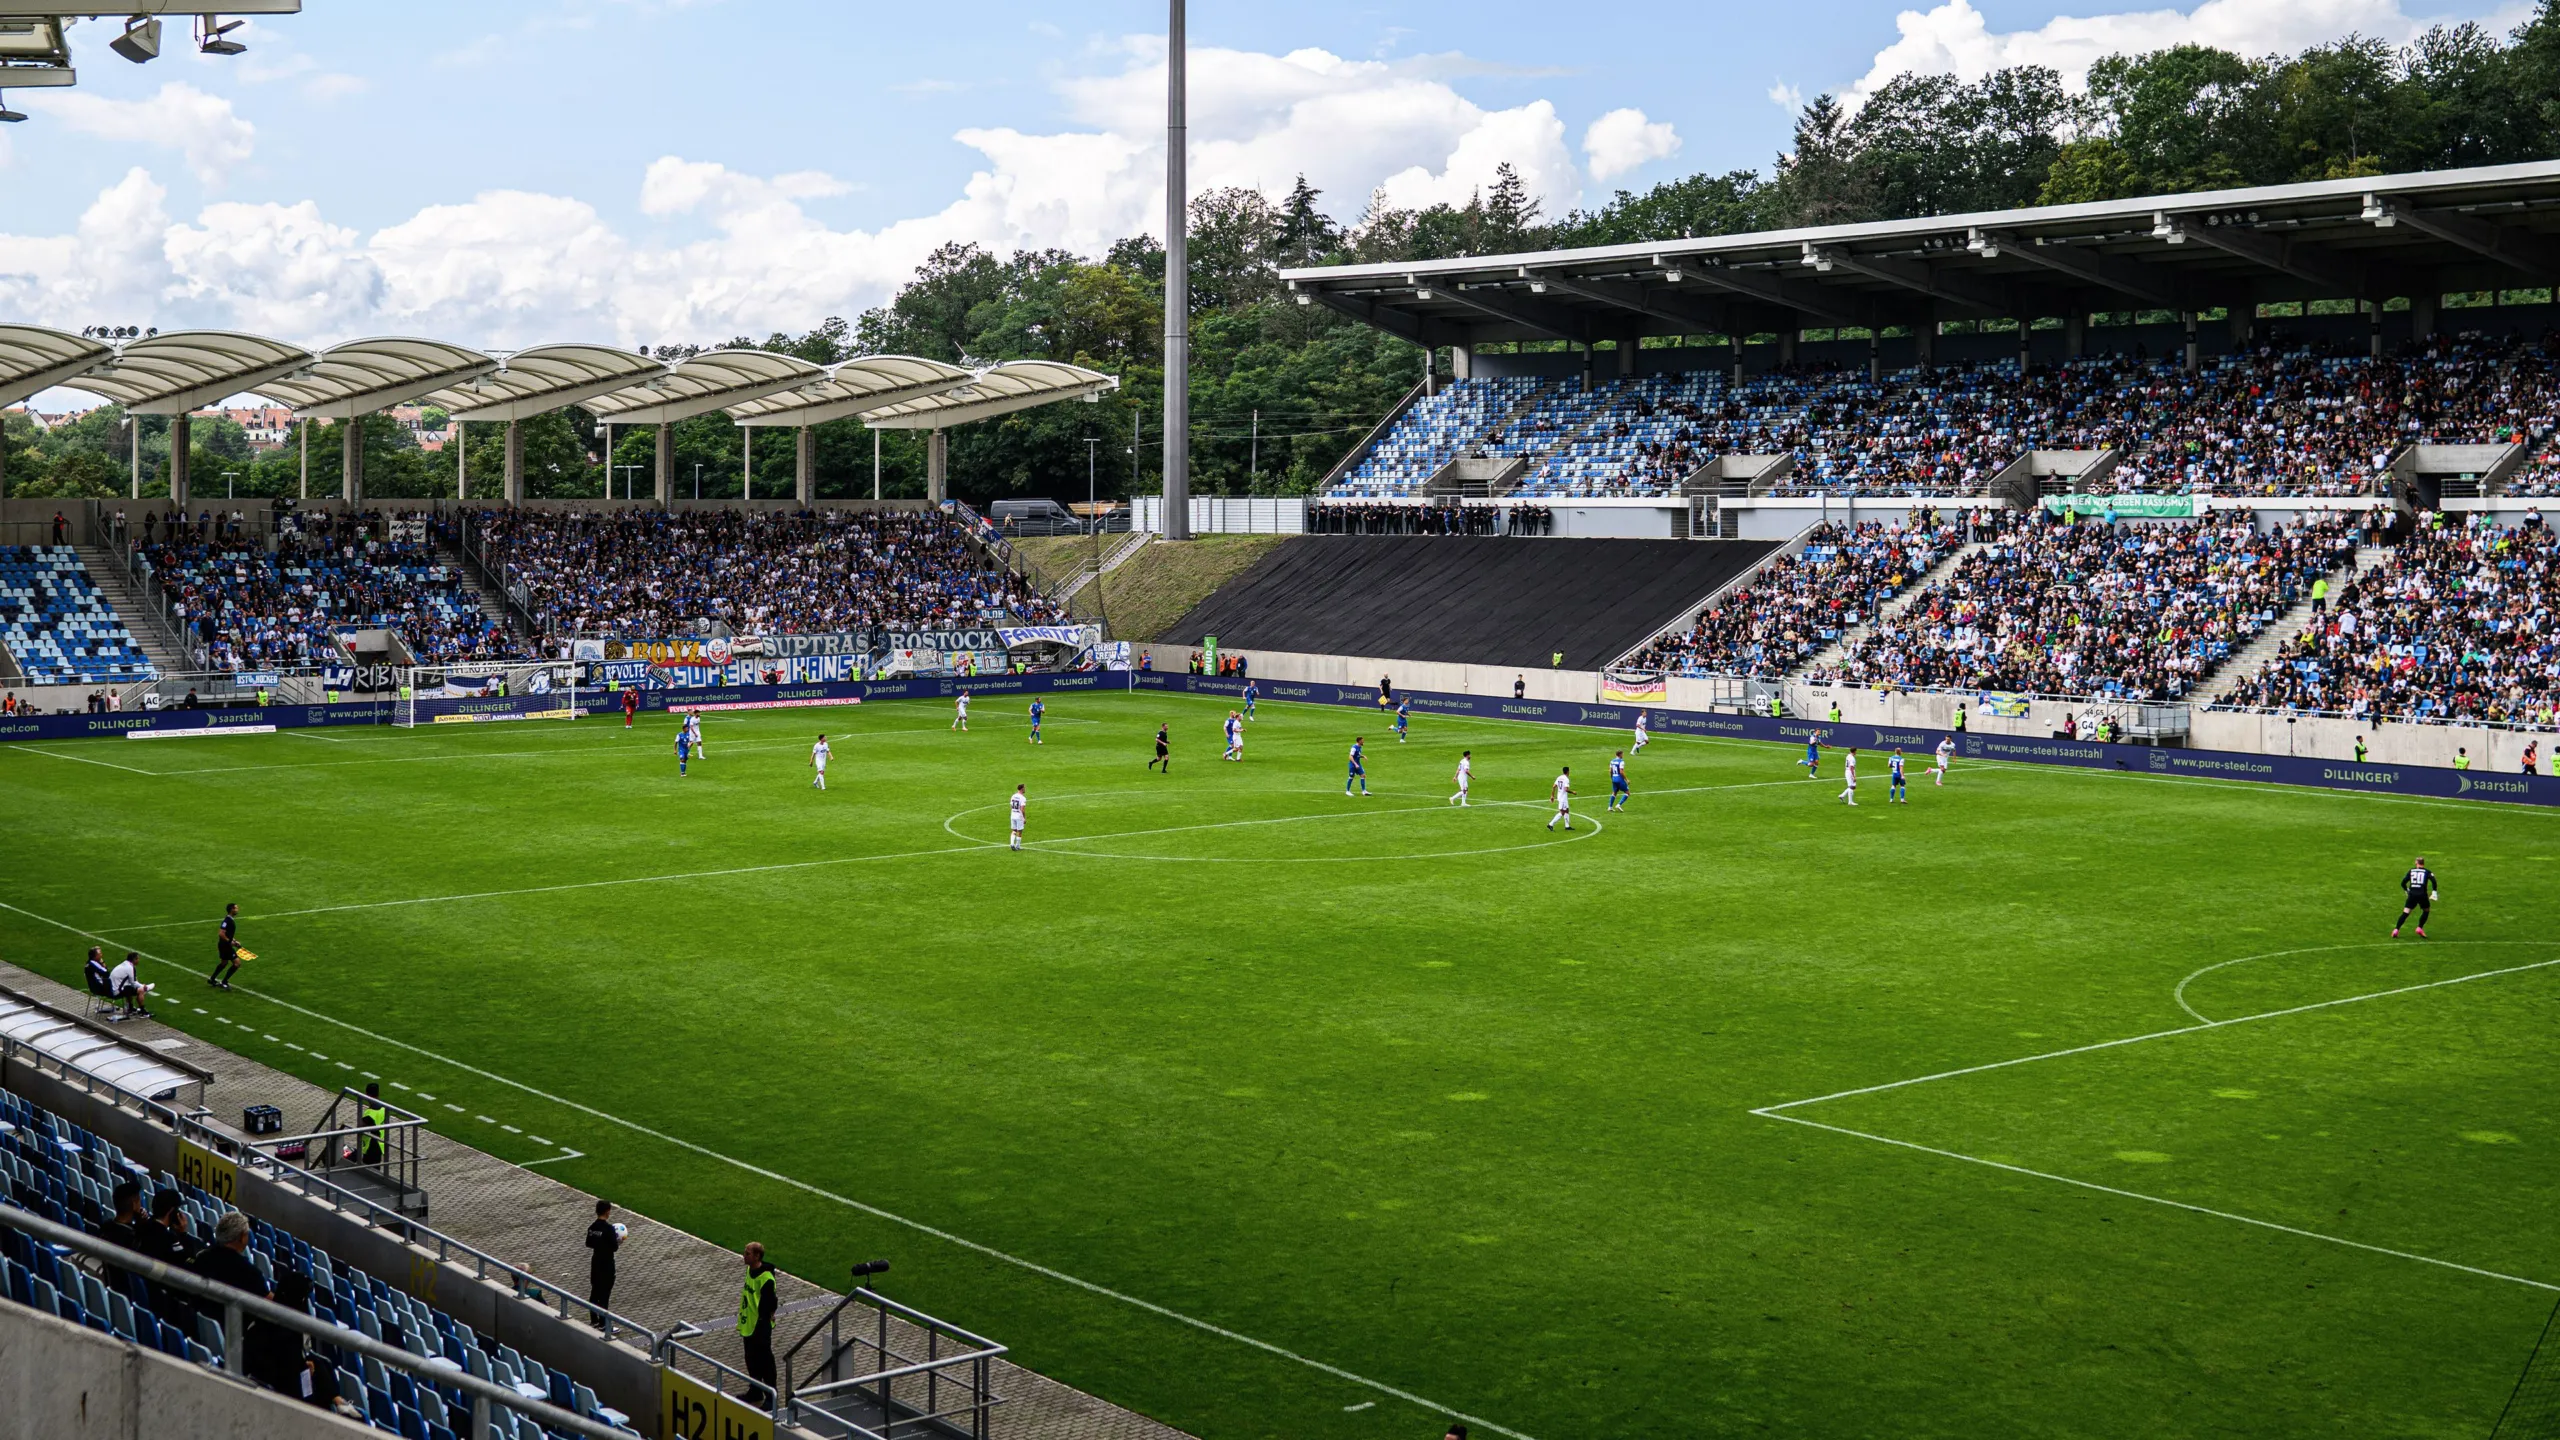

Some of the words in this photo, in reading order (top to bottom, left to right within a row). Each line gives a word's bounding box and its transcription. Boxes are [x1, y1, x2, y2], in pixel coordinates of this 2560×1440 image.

[2044, 497, 2058, 506] WIR
[2062, 497, 2091, 506] HABEN
[2112, 498, 2141, 506] GEGEN
[762, 634, 869, 657] SUPTRAS
[888, 630, 996, 650] ROSTOCK
[632, 640, 702, 664] BOYZ
[605, 663, 645, 680] REVOLTE
[955, 681, 1022, 690] www.pure-steel.com
[1053, 677, 1094, 686] DILLINGER
[777, 689, 824, 699] DILLINGER
[873, 684, 907, 694] saarstahl
[1273, 687, 1307, 697] DILLINGER
[665, 692, 741, 703] www.pure-steel.com
[1345, 691, 1371, 700] saarstahl
[572, 696, 608, 707] aarstahl
[709, 702, 749, 711] FLYERALARM
[749, 701, 786, 710] FLYERALARM
[786, 699, 824, 708] FLYERALARM
[824, 697, 860, 706] FLYERALARM
[1413, 697, 1473, 709] www.pure-steel.com
[1757, 698, 1767, 707] G3
[458, 703, 512, 713] DILLINGER
[1502, 704, 1543, 715] DILLINGER
[218, 712, 263, 724] saarstahl
[1588, 710, 1621, 720] saarstahl
[88, 718, 150, 731] DILLINGER
[1671, 718, 1743, 731] www.pure-steel.com
[2082, 720, 2094, 730] G4
[1779, 726, 1829, 739] DILLINGR
[1884, 734, 1924, 745] saarstahl
[2059, 747, 2103, 759] saarstahl
[2149, 761, 2167, 770] Steel
[2173, 757, 2272, 773] www.pure-steel.com
[2323, 768, 2393, 784] DILLINGER
[2473, 780, 2529, 793] saarstahl
[2411, 871, 2425, 884] 20
[183, 1153, 202, 1189] H3
[213, 1167, 233, 1204] H2
[672, 1389, 707, 1440] H2
